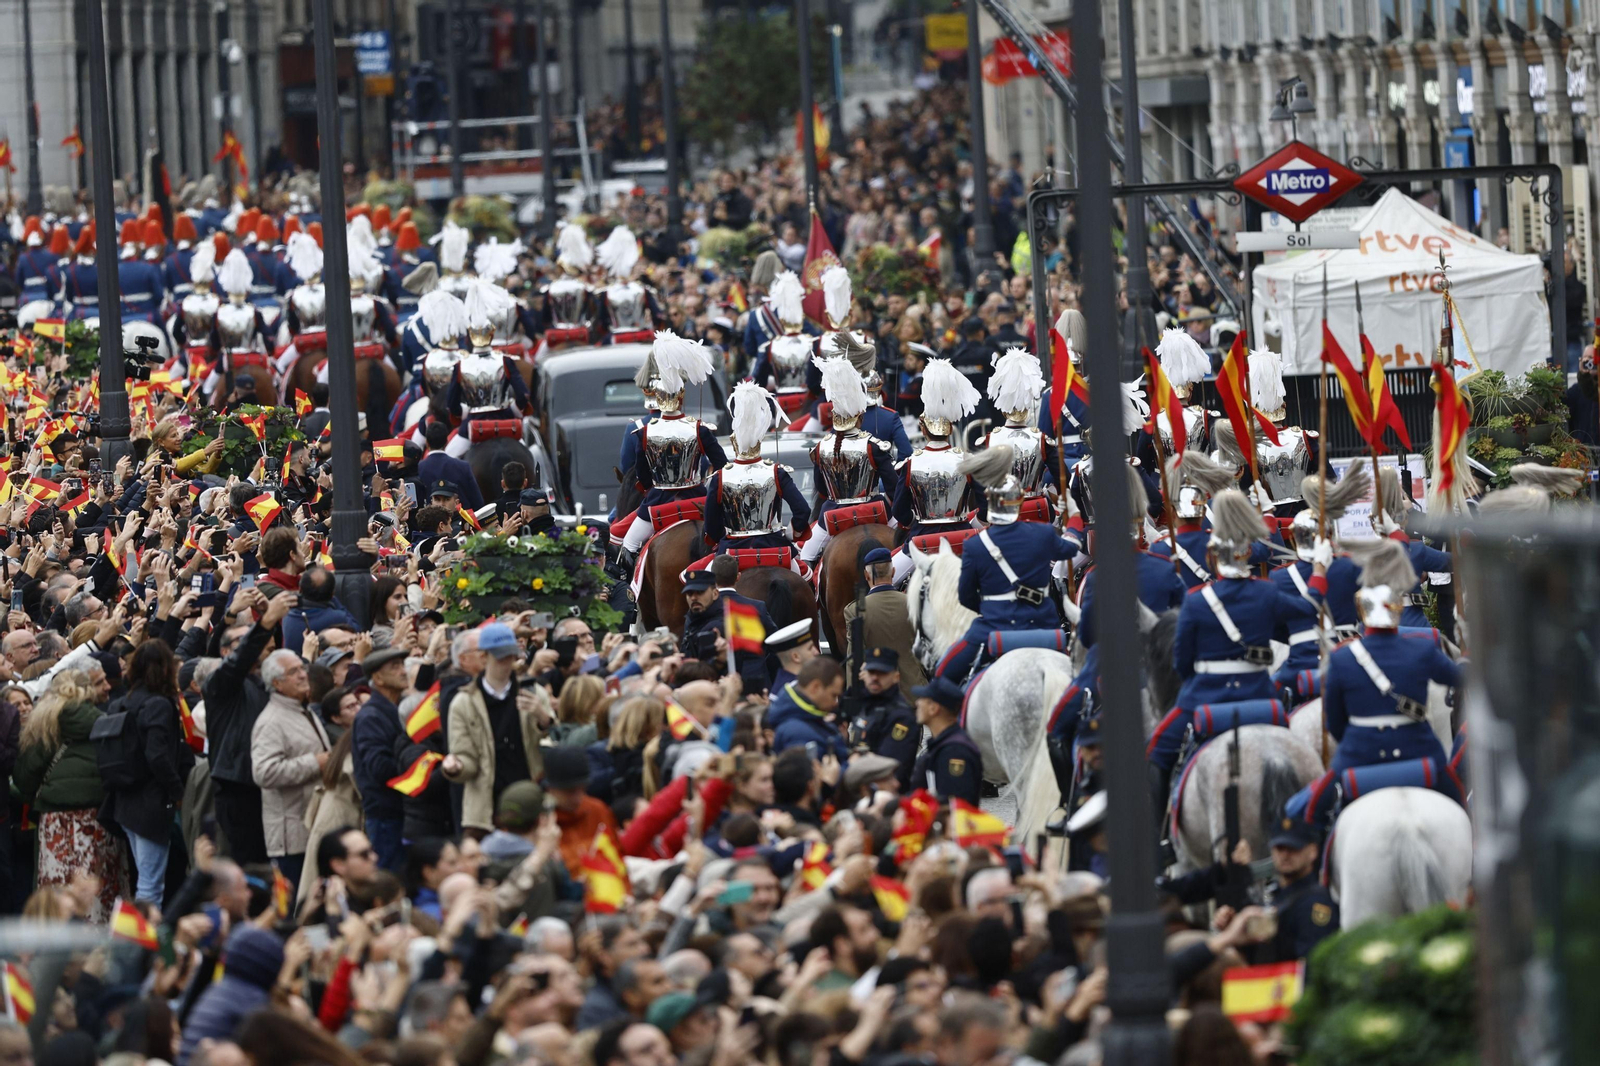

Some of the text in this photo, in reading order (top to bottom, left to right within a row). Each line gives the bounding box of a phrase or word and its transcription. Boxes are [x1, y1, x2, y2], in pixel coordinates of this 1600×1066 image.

[1271, 173, 1326, 191] Metro
[1286, 235, 1312, 247] Sol
[1359, 230, 1454, 256] rtve
[1388, 271, 1446, 294] rtve
